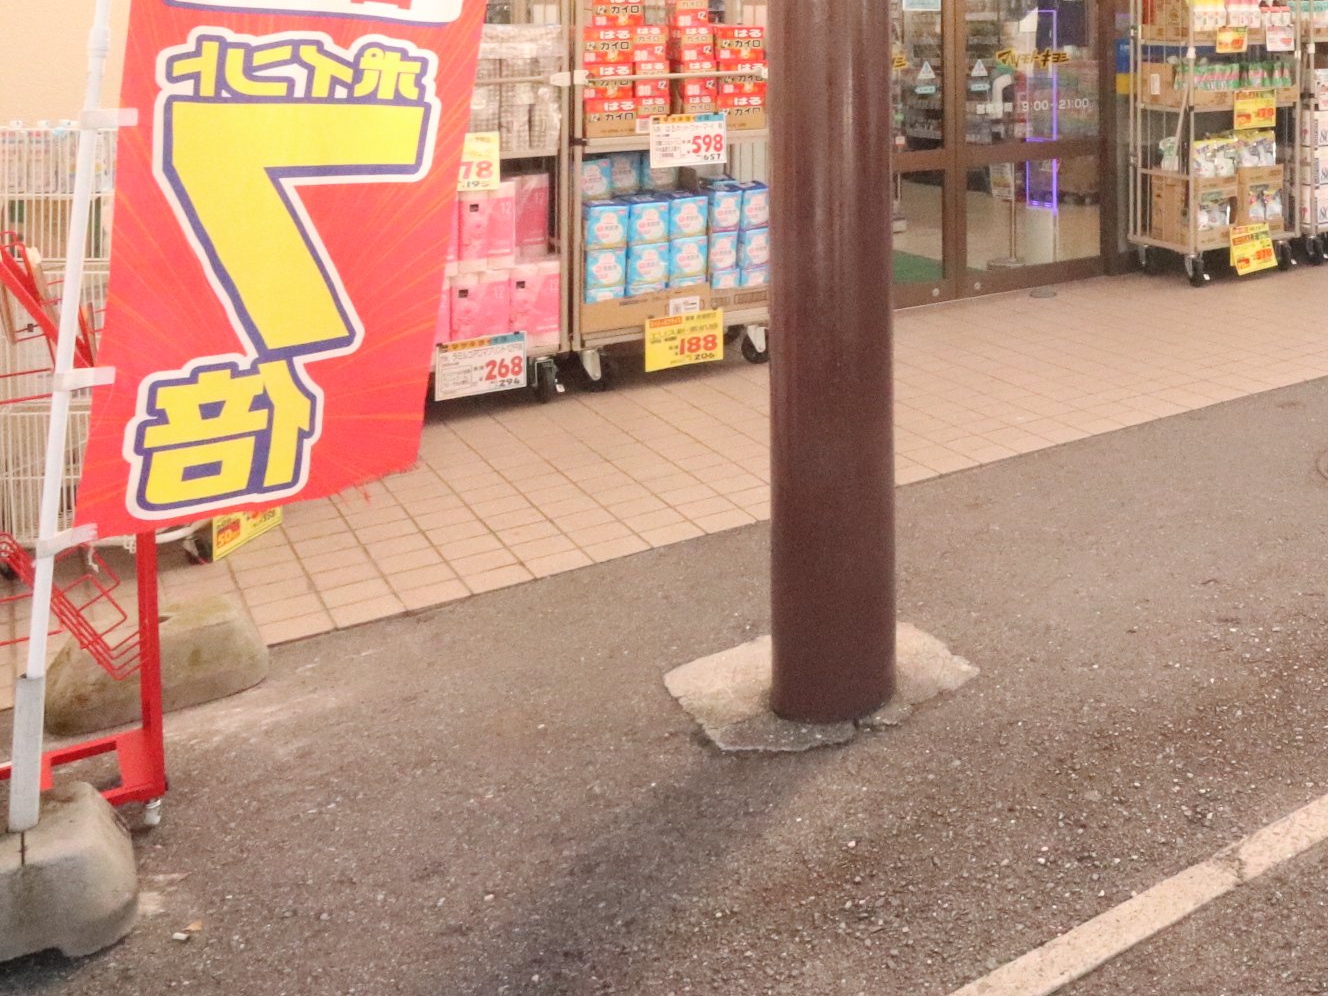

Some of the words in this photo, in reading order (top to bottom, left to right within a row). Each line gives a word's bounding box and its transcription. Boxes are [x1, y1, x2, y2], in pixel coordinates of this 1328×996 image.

[612, 6, 640, 14] カイロ
[600, 30, 630, 39] はる
[734, 29, 761, 37] はる
[600, 42, 629, 50] カイロ
[604, 102, 634, 111] はる
[692, 134, 723, 154] 598
[679, 334, 717, 355] 188
[485, 356, 523, 381] 268
